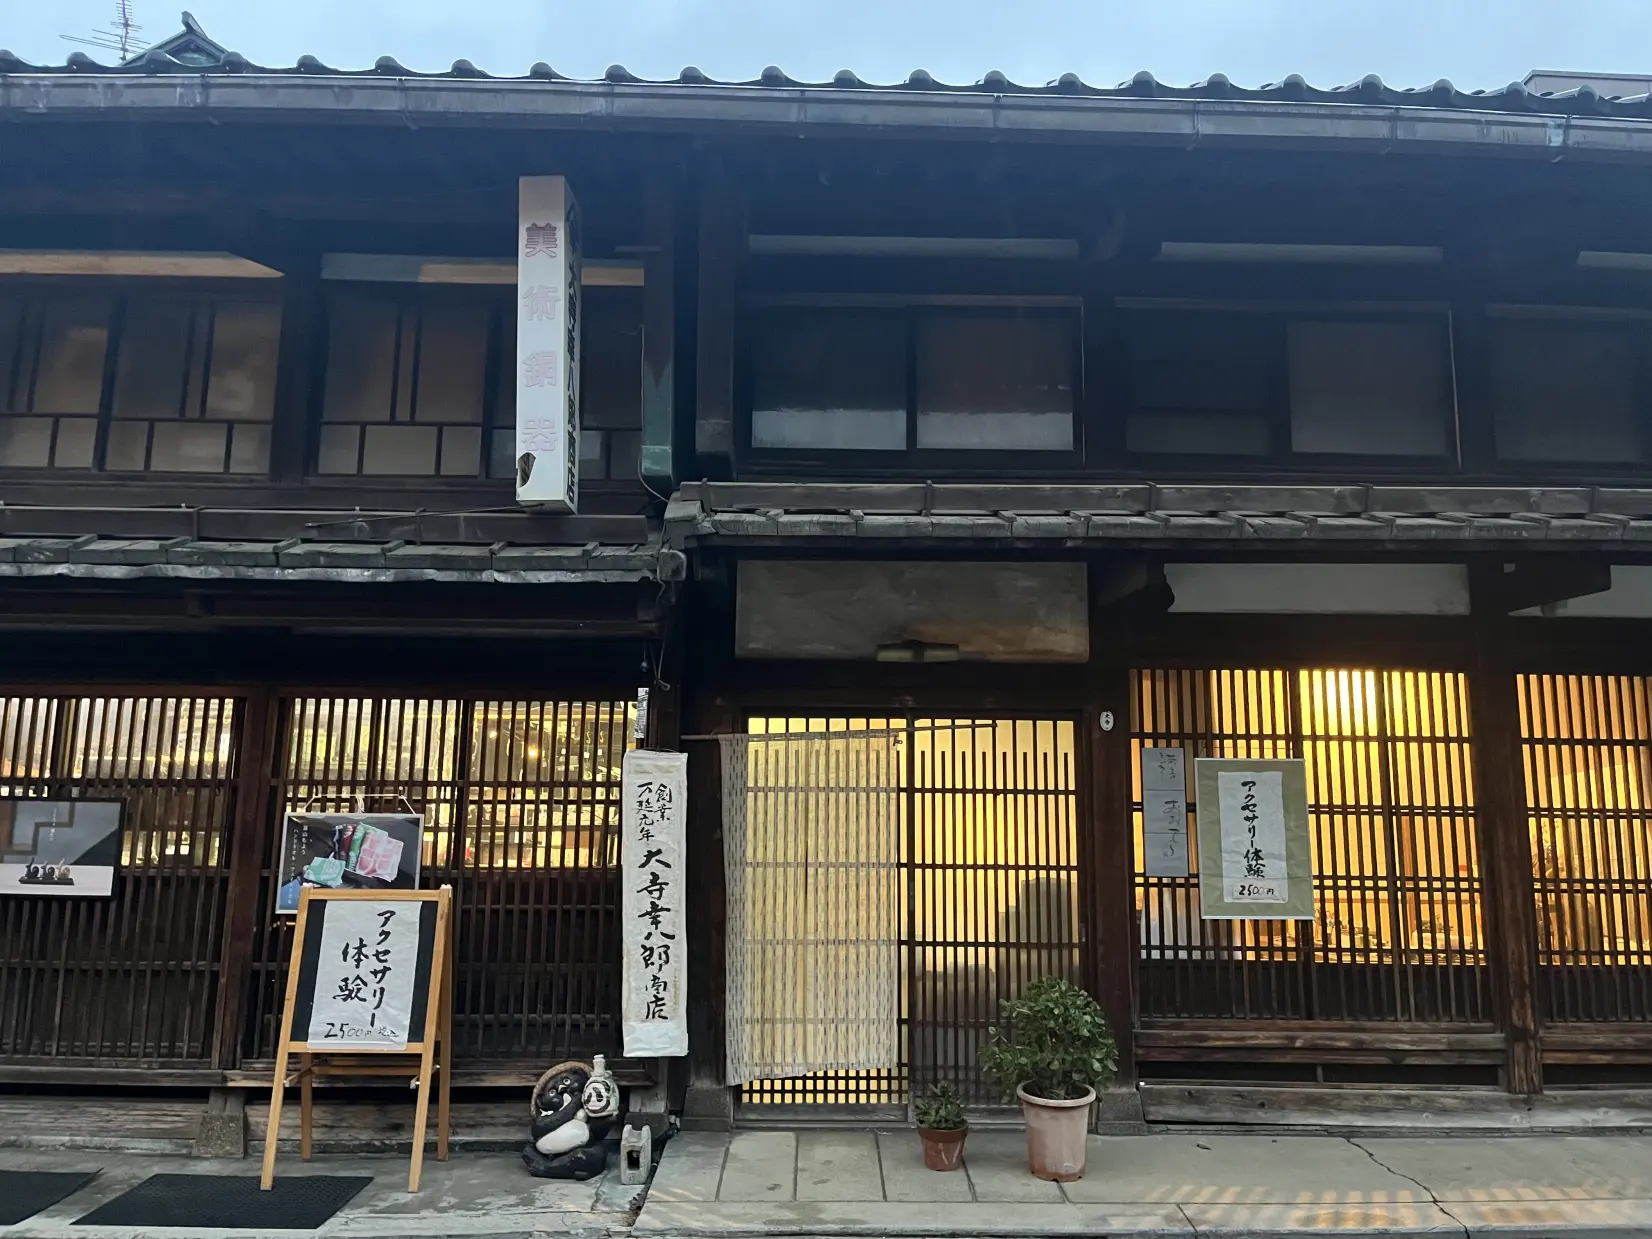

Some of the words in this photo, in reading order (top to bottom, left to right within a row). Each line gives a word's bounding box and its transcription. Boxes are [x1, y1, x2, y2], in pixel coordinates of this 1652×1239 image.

[521, 222, 560, 452] 美術銅器
[636, 782, 655, 842] 万延元年
[655, 783, 673, 822] 創業
[1241, 780, 1266, 879] アクセサリー体験
[332, 937, 369, 1002] 体験
[369, 910, 396, 1028] アクセサリー
[636, 848, 675, 1020] 大寺幸八郎商店
